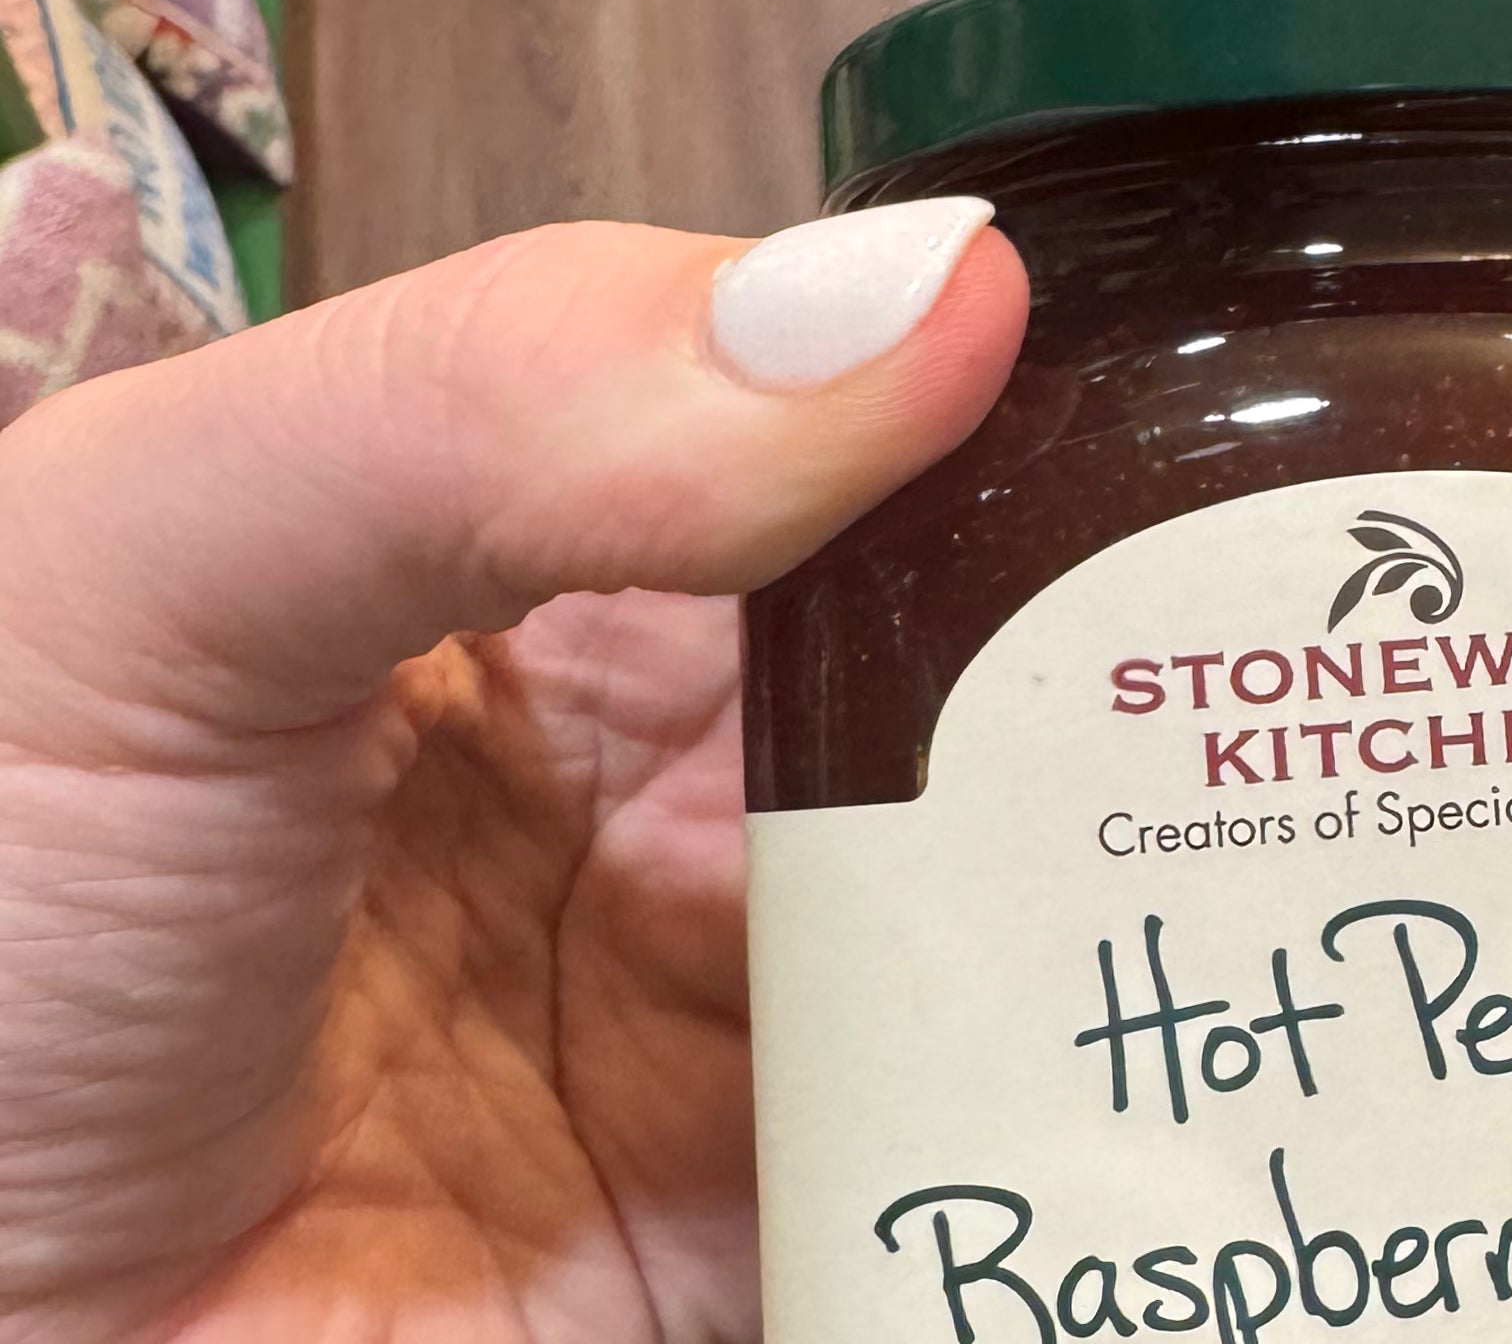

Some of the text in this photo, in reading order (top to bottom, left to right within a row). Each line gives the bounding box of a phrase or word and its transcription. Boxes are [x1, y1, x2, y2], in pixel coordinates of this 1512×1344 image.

[1098, 811, 1295, 856] Creators
[1314, 790, 1360, 840] of
[1074, 914, 1344, 1124] Hot
